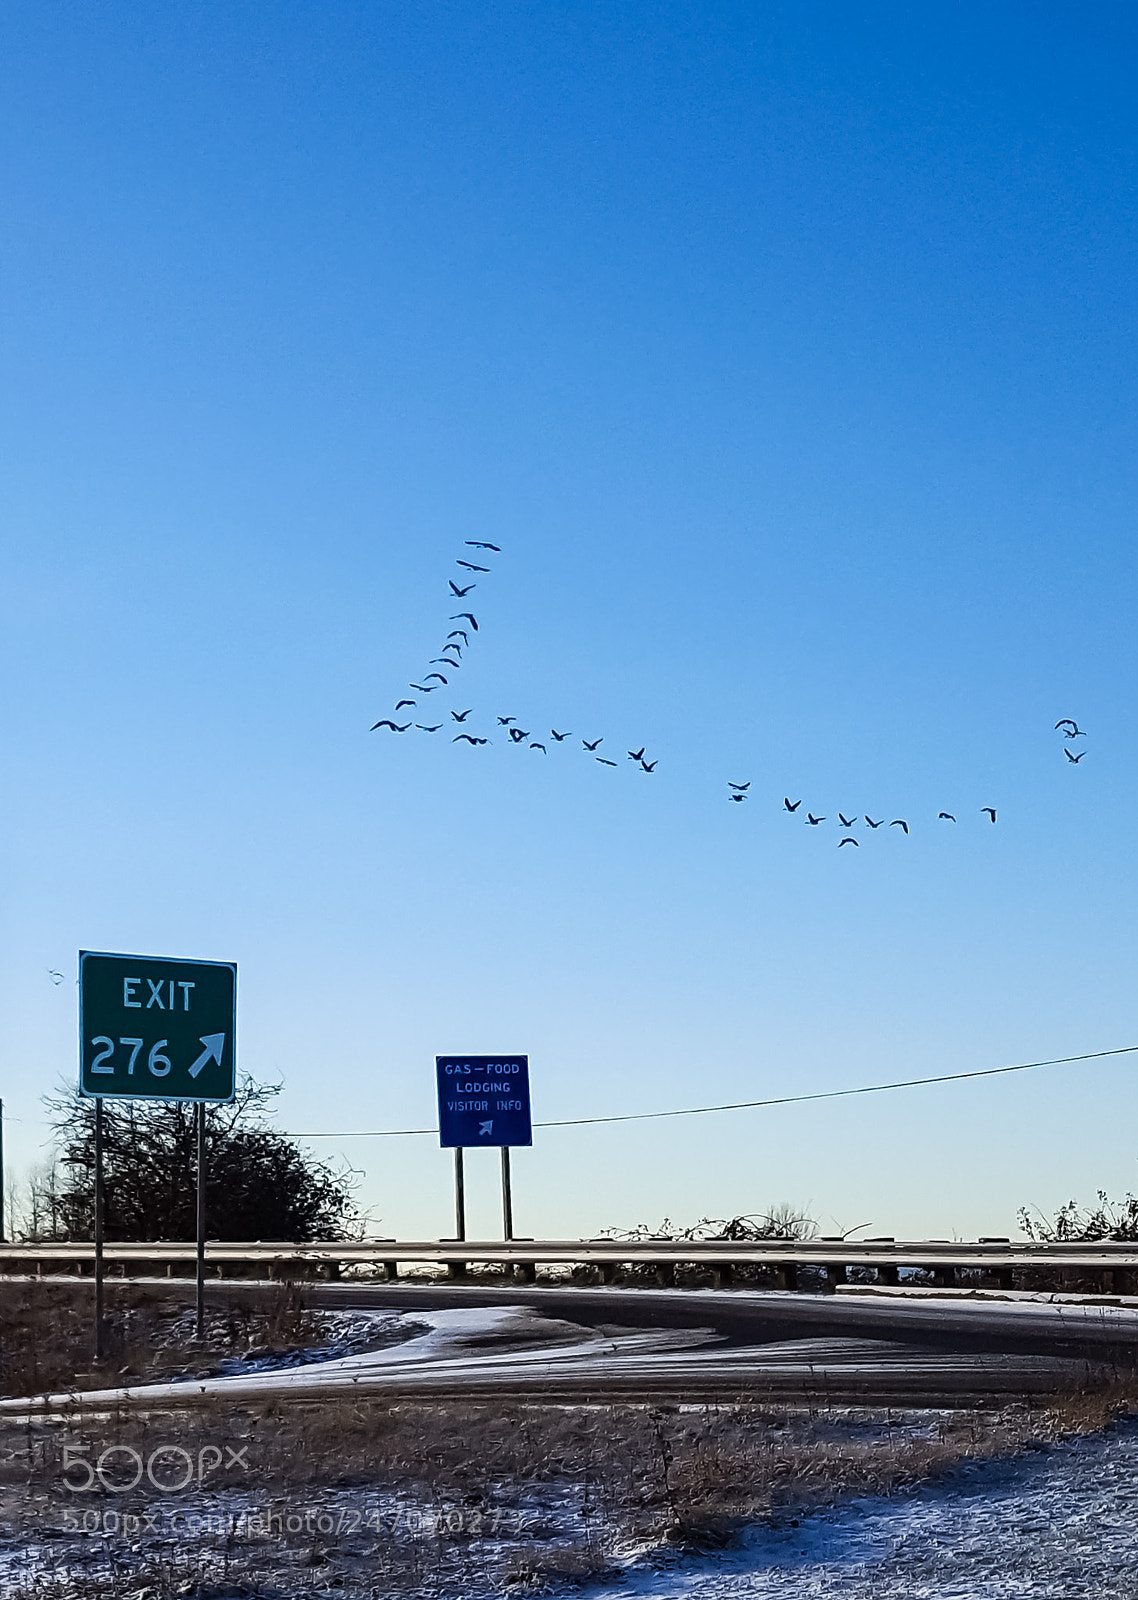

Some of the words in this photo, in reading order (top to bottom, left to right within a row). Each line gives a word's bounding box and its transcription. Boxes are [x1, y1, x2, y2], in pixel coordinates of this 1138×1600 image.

[123, 977, 196, 1011] EXIT
[90, 1035, 172, 1077] 276
[456, 1082, 511, 1093] LODGING
[447, 1100, 489, 1112] VISITOR
[496, 1100, 522, 1111] INFO
